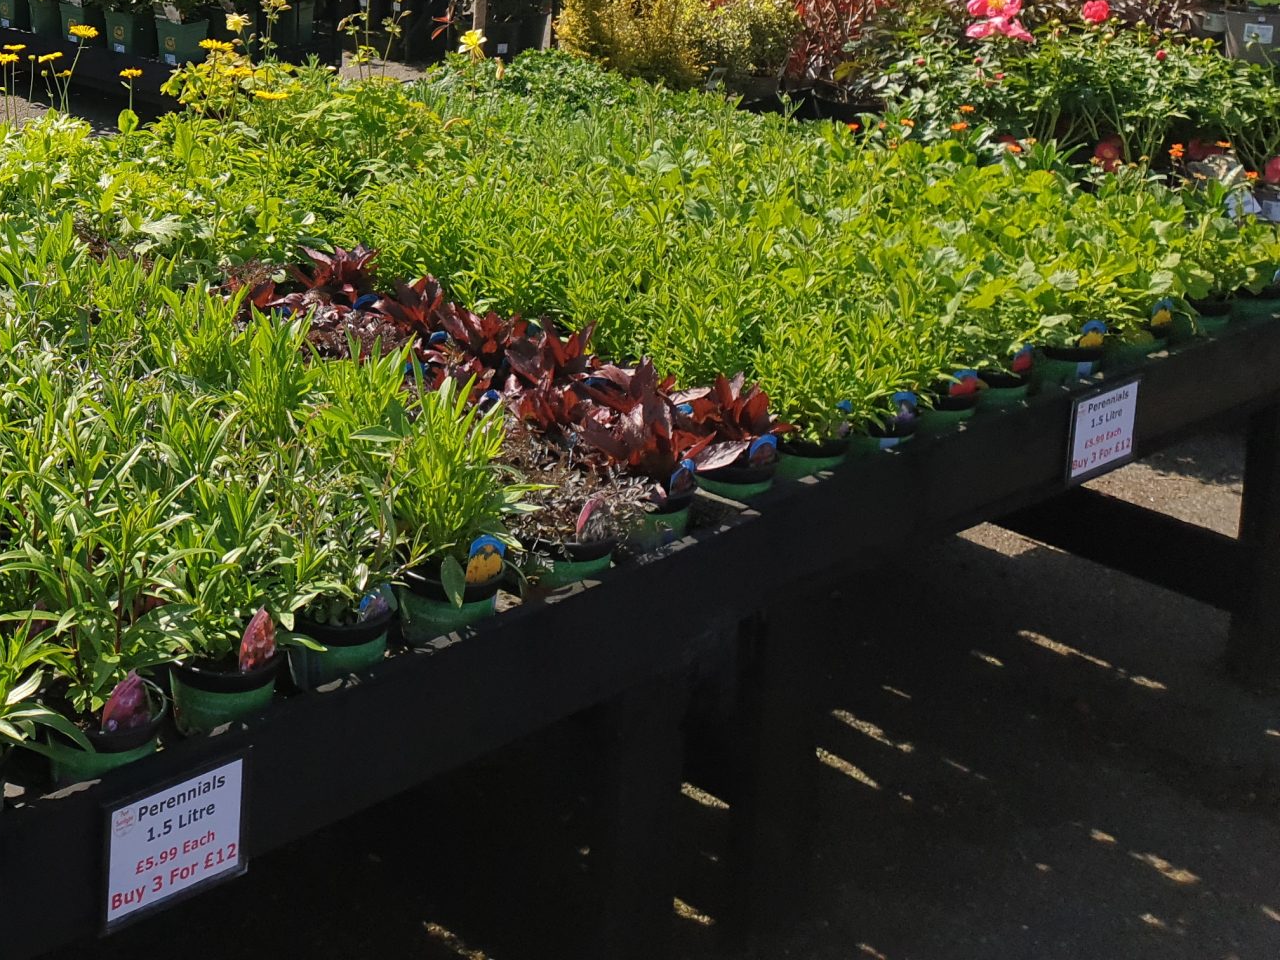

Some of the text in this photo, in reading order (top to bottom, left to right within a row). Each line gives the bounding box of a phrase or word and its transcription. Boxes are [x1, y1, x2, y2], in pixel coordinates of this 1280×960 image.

[1087, 390, 1129, 414] Perennials
[1091, 408, 1123, 428] 1.5 Litre
[1106, 427, 1122, 440] Each
[1072, 438, 1131, 470] Buy 3 For £12
[137, 773, 226, 822] Perennials
[146, 819, 173, 842] 1.5
[178, 802, 216, 830] Litre
[135, 830, 216, 875] £5.99 Each
[111, 842, 237, 911] Buy 3 For £12
